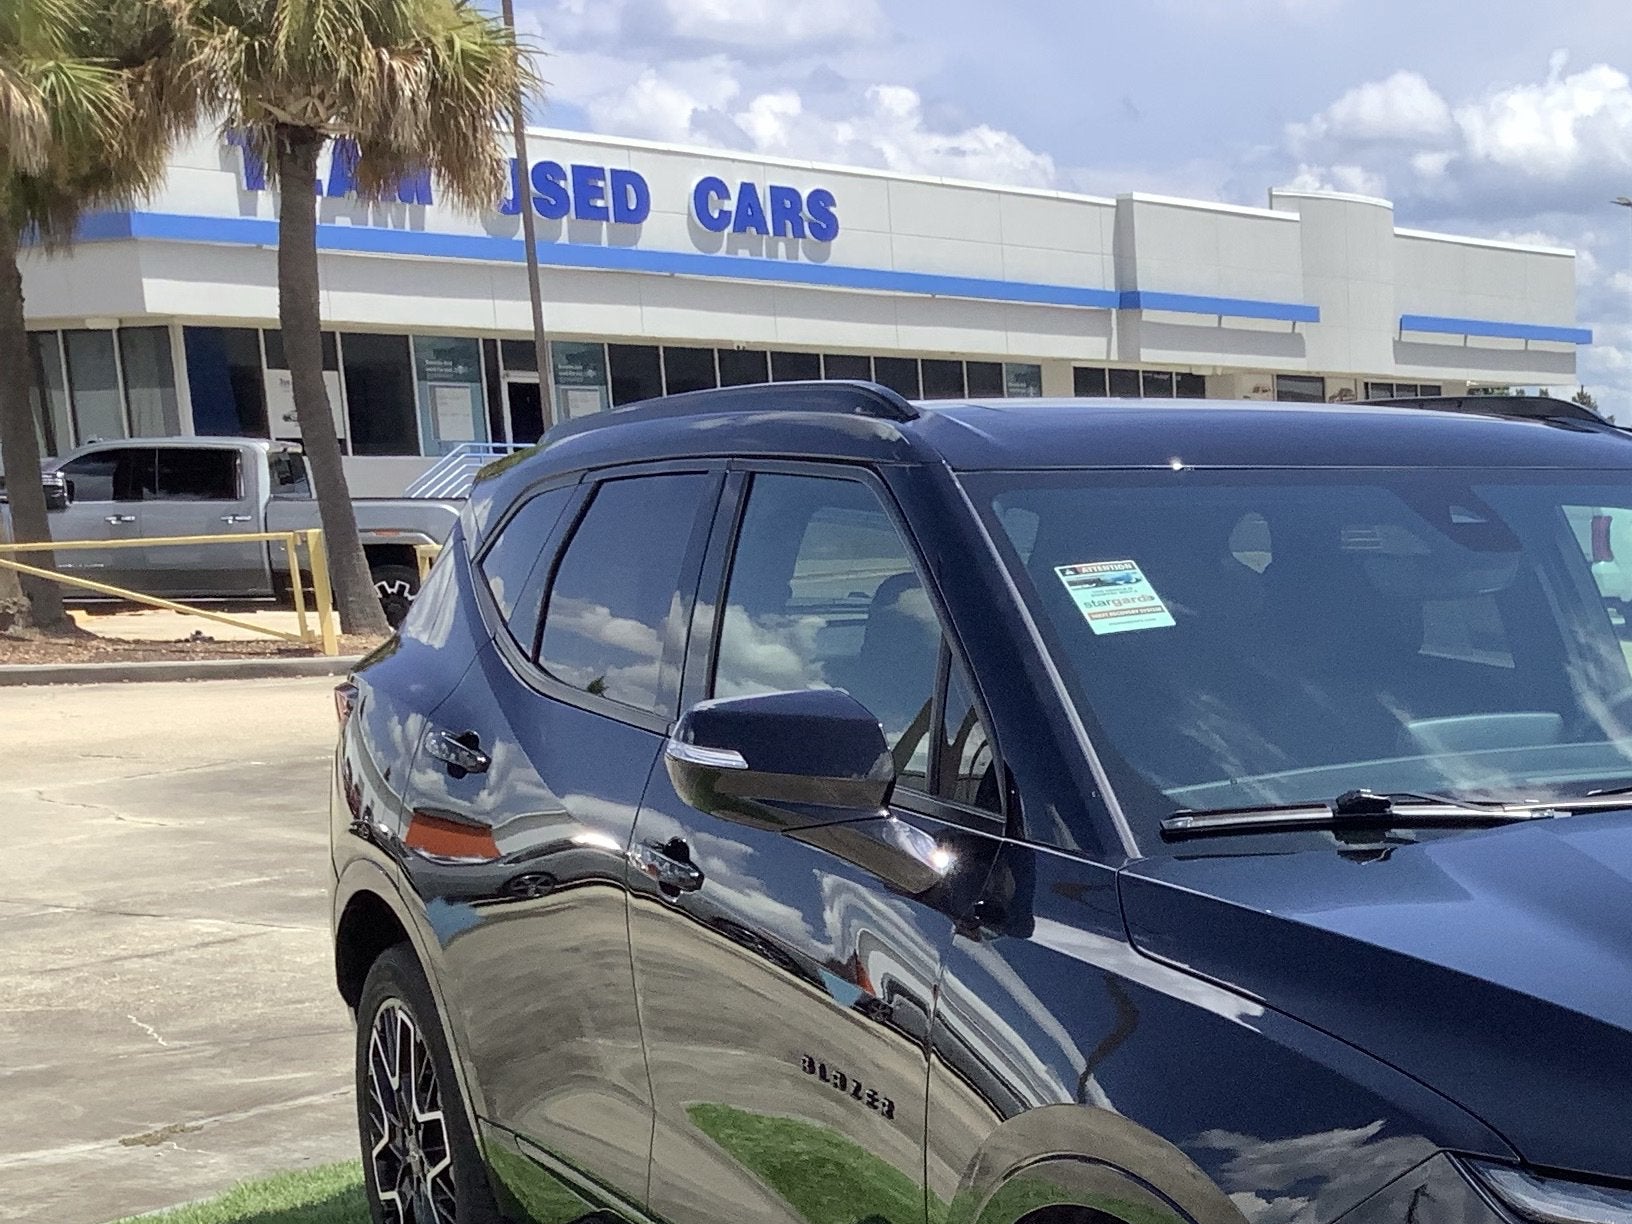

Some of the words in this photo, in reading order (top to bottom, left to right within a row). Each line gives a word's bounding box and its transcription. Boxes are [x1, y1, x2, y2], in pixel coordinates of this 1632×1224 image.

[693, 176, 840, 242] CARS
[1081, 562, 1133, 573] ATTENTION
[802, 1054, 895, 1119] BLAZER
